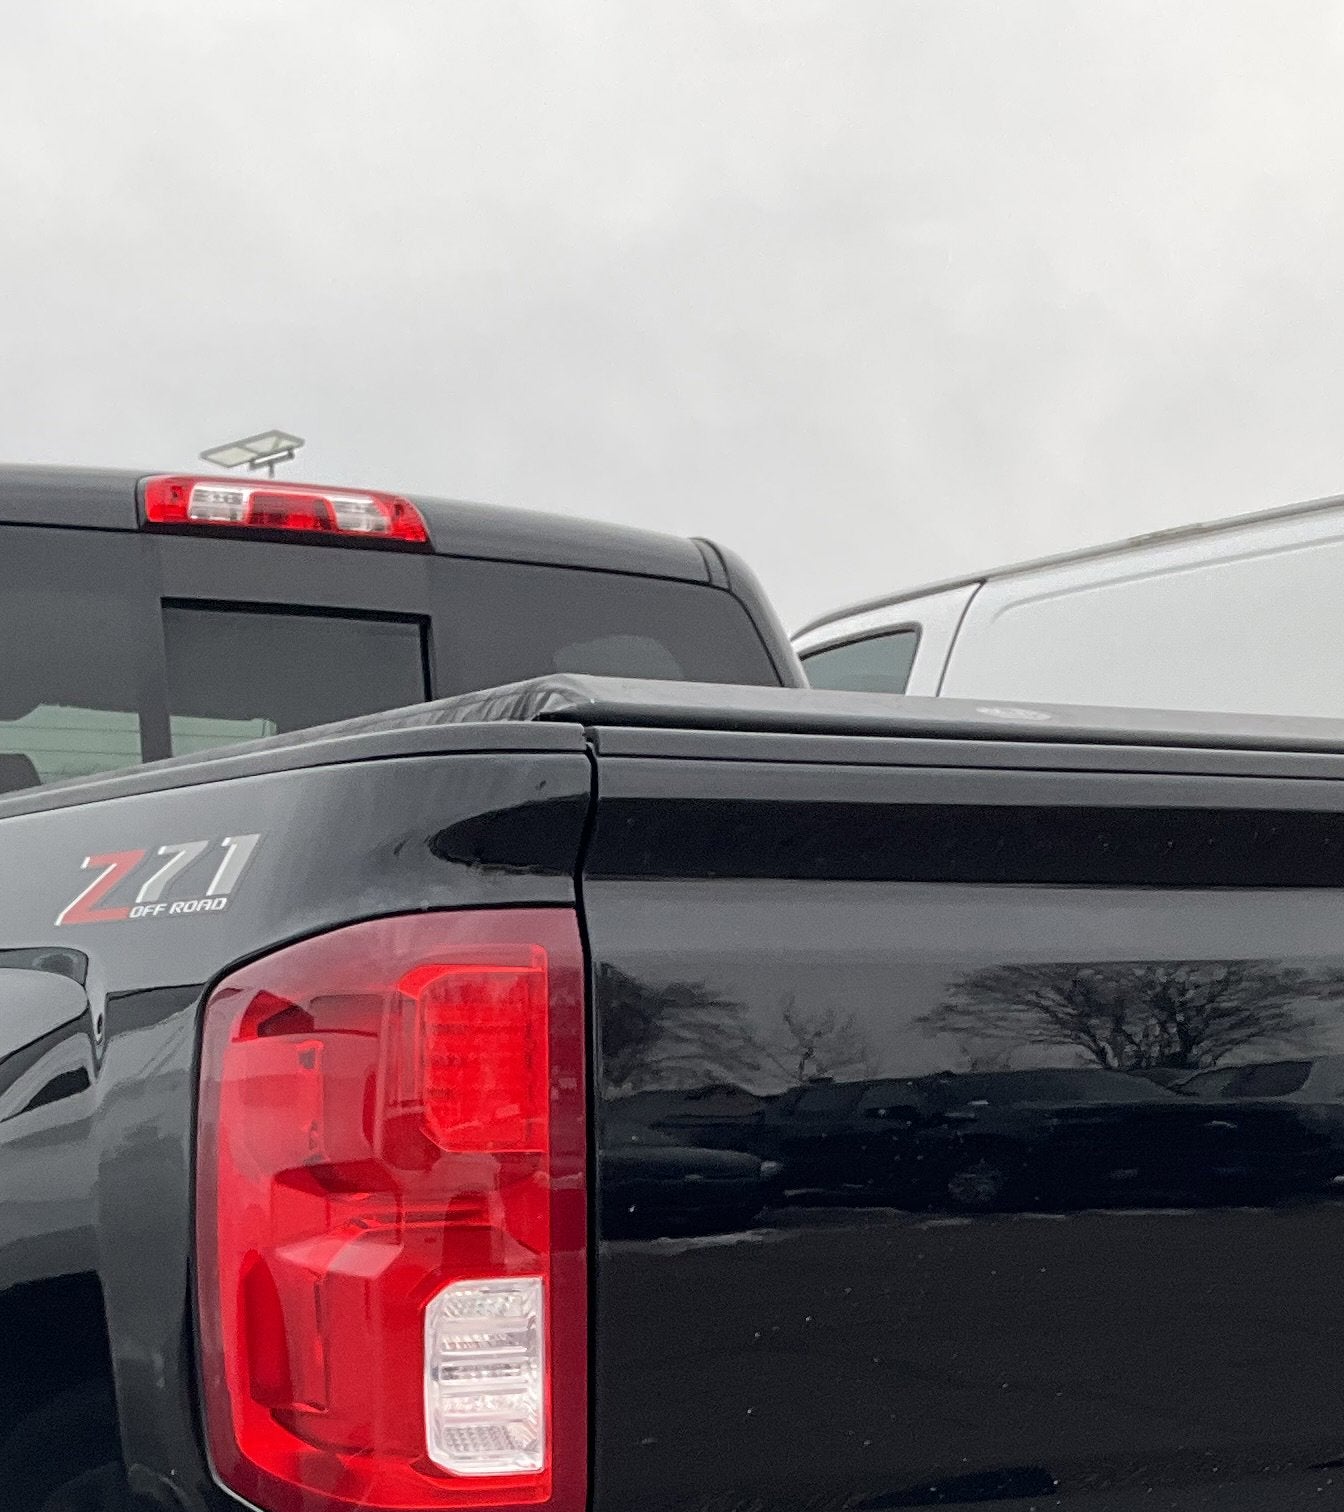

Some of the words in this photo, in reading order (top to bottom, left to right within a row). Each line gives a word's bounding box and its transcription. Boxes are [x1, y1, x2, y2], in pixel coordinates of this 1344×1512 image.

[54, 834, 261, 926] Z71
[129, 903, 168, 918] OFF
[170, 898, 228, 913] ROAD
